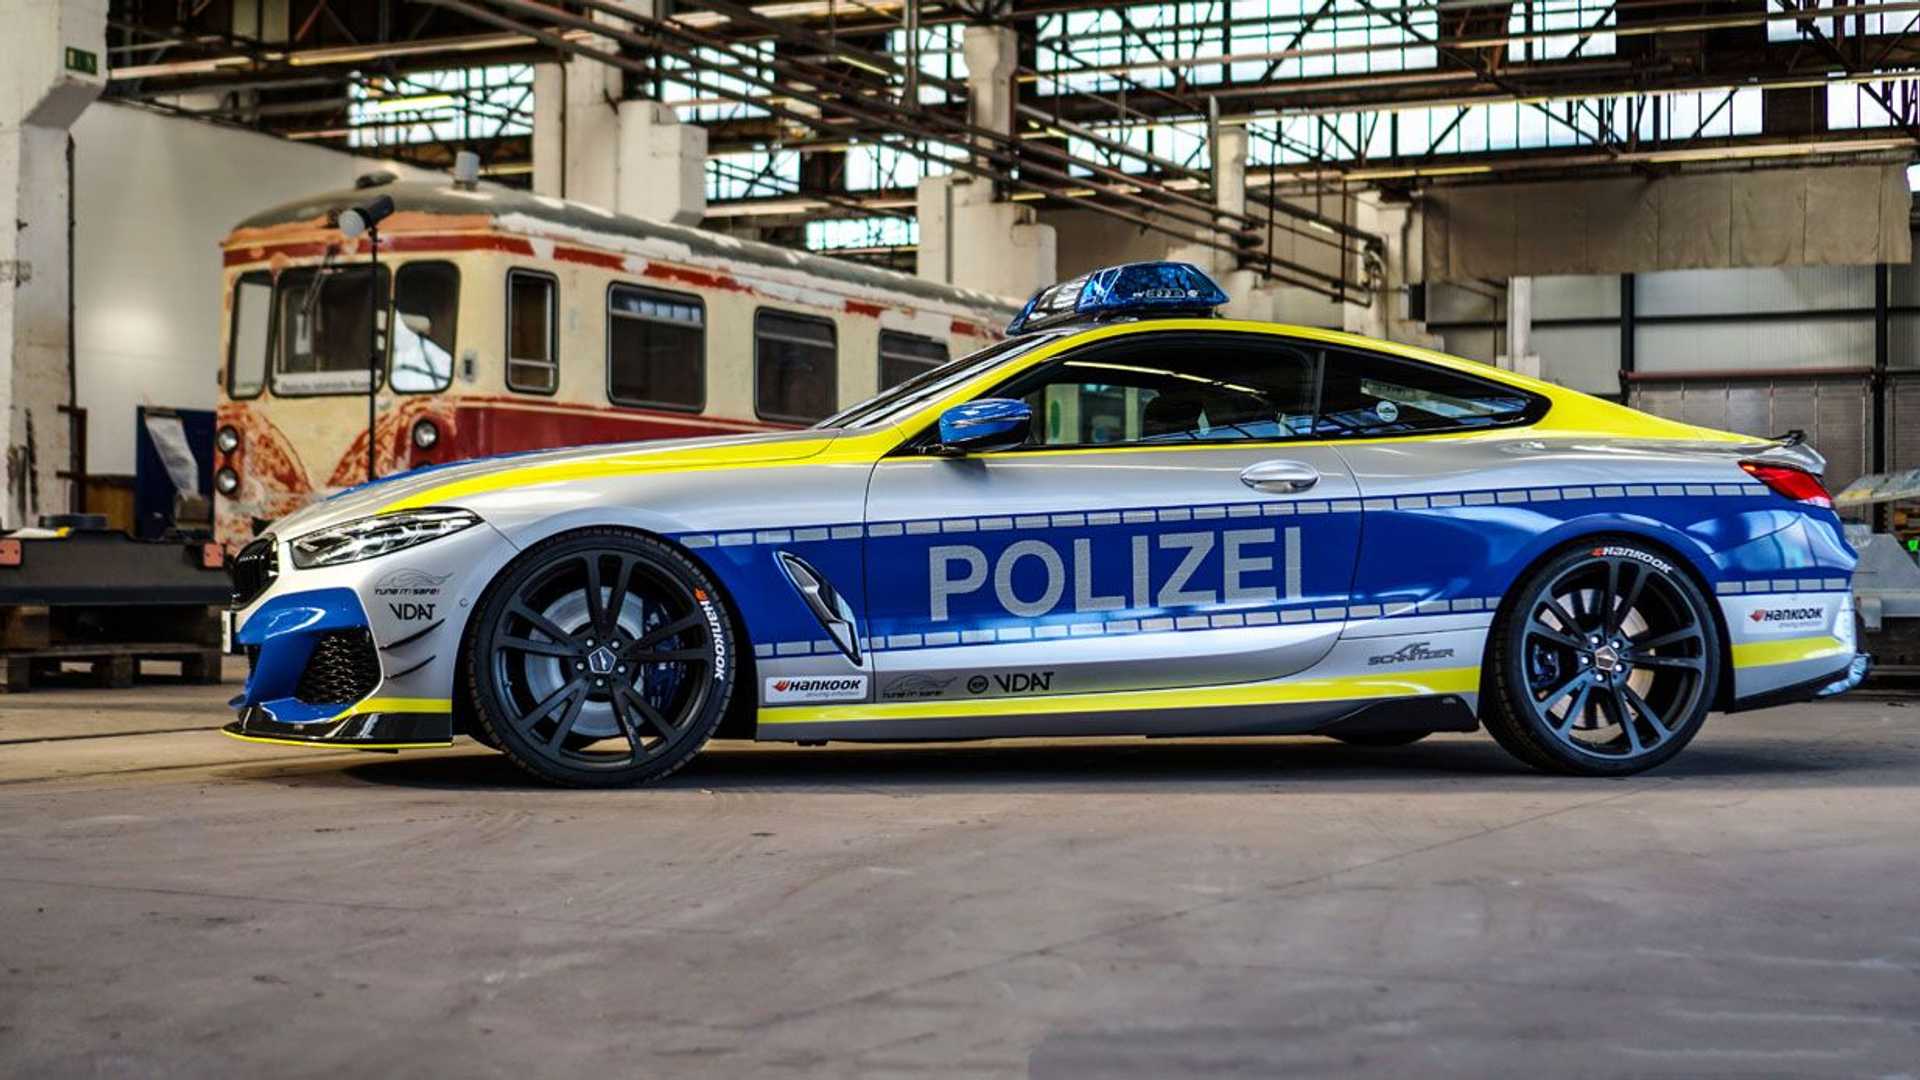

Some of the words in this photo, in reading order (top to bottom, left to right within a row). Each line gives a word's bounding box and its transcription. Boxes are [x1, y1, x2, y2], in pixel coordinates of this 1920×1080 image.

[929, 526, 1302, 622] POLIZEI
[388, 602, 436, 621] VDAT
[993, 671, 1055, 693] VDAT
